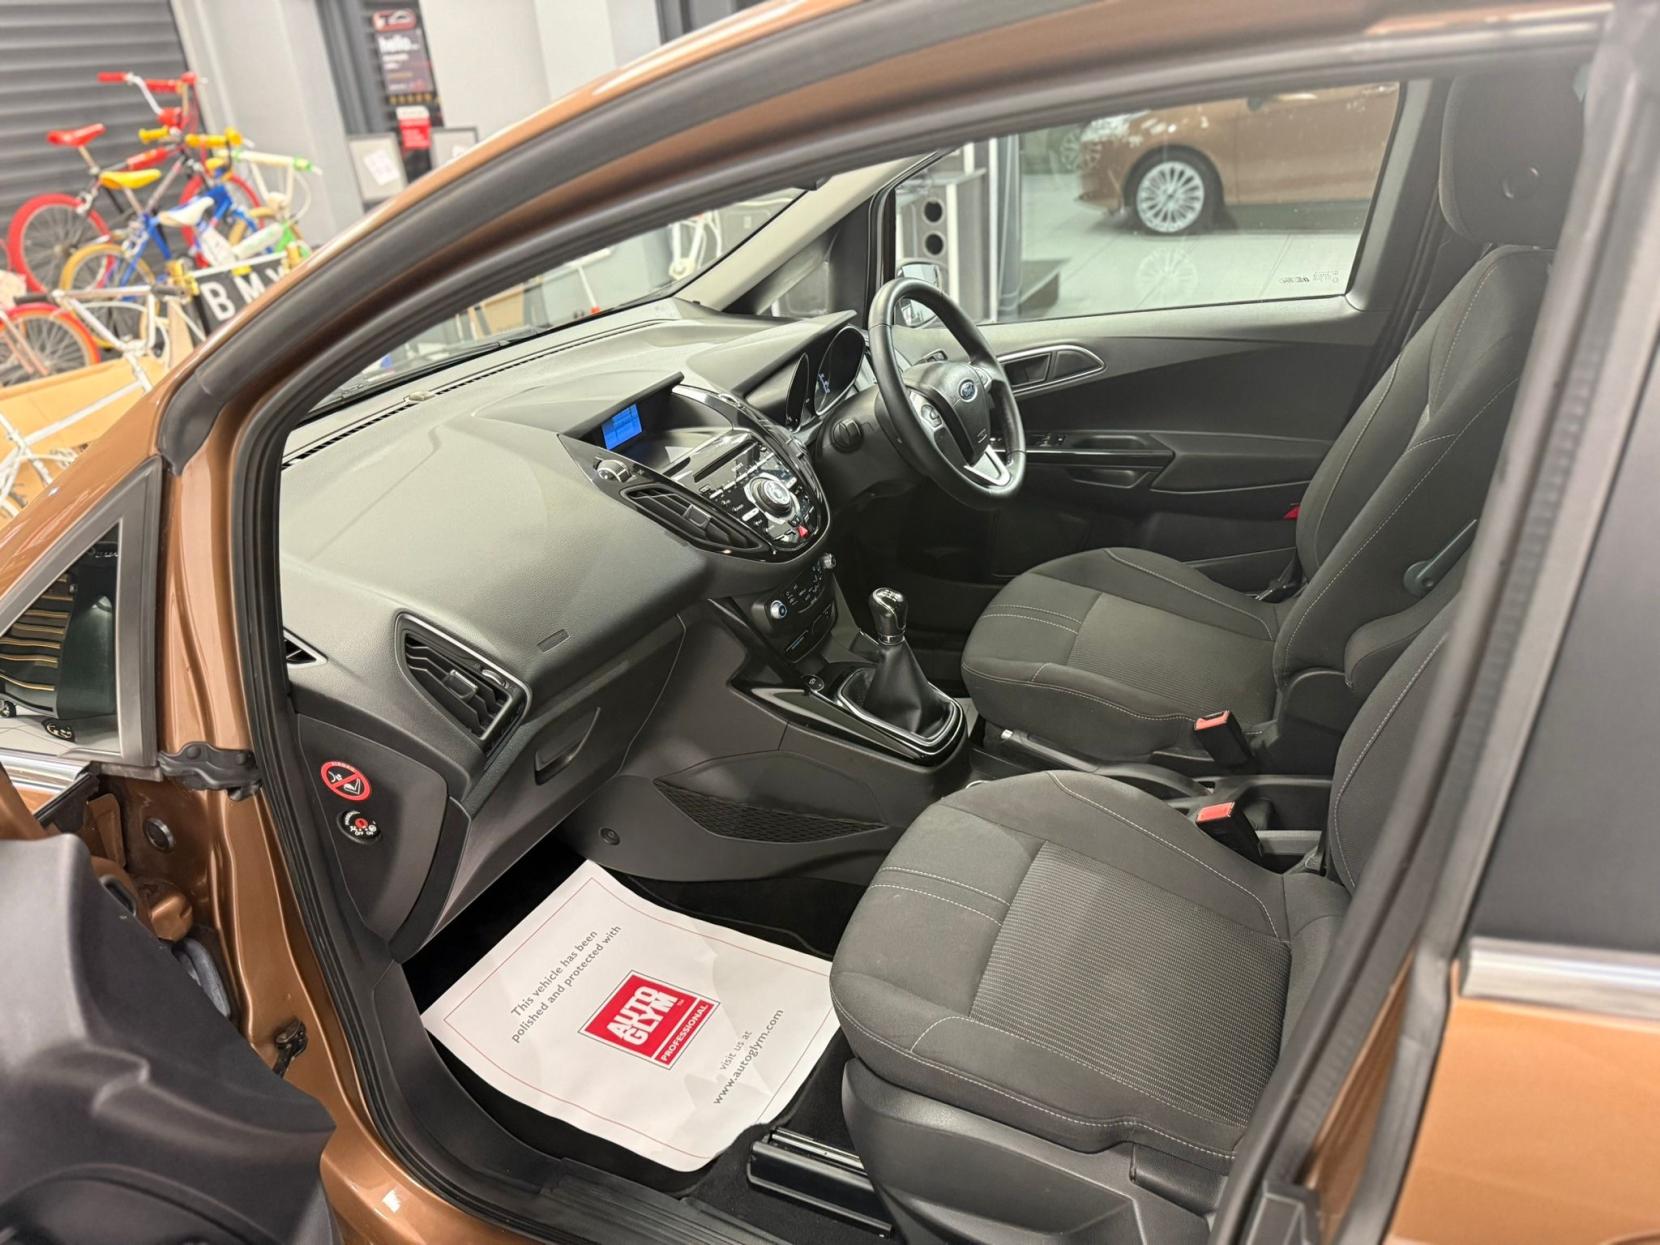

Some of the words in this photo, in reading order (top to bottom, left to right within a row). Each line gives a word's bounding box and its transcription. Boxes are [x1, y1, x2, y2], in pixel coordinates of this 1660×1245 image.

[511, 997, 534, 1016] This
[533, 967, 563, 997] vehicle
[560, 951, 578, 967] has
[575, 931, 598, 952] been
[512, 1002, 549, 1043] polished
[547, 984, 565, 1004] and
[564, 943, 604, 987] protected
[602, 926, 621, 944] with
[606, 986, 660, 1040] AUTO
[622, 991, 679, 1046] GLYM
[661, 1004, 709, 1061] PROFESSIONAL
[713, 1009, 784, 1104] www.autoglym.com
[720, 1053, 736, 1070] visit
[734, 1041, 744, 1051] us
[742, 1031, 752, 1040] at
